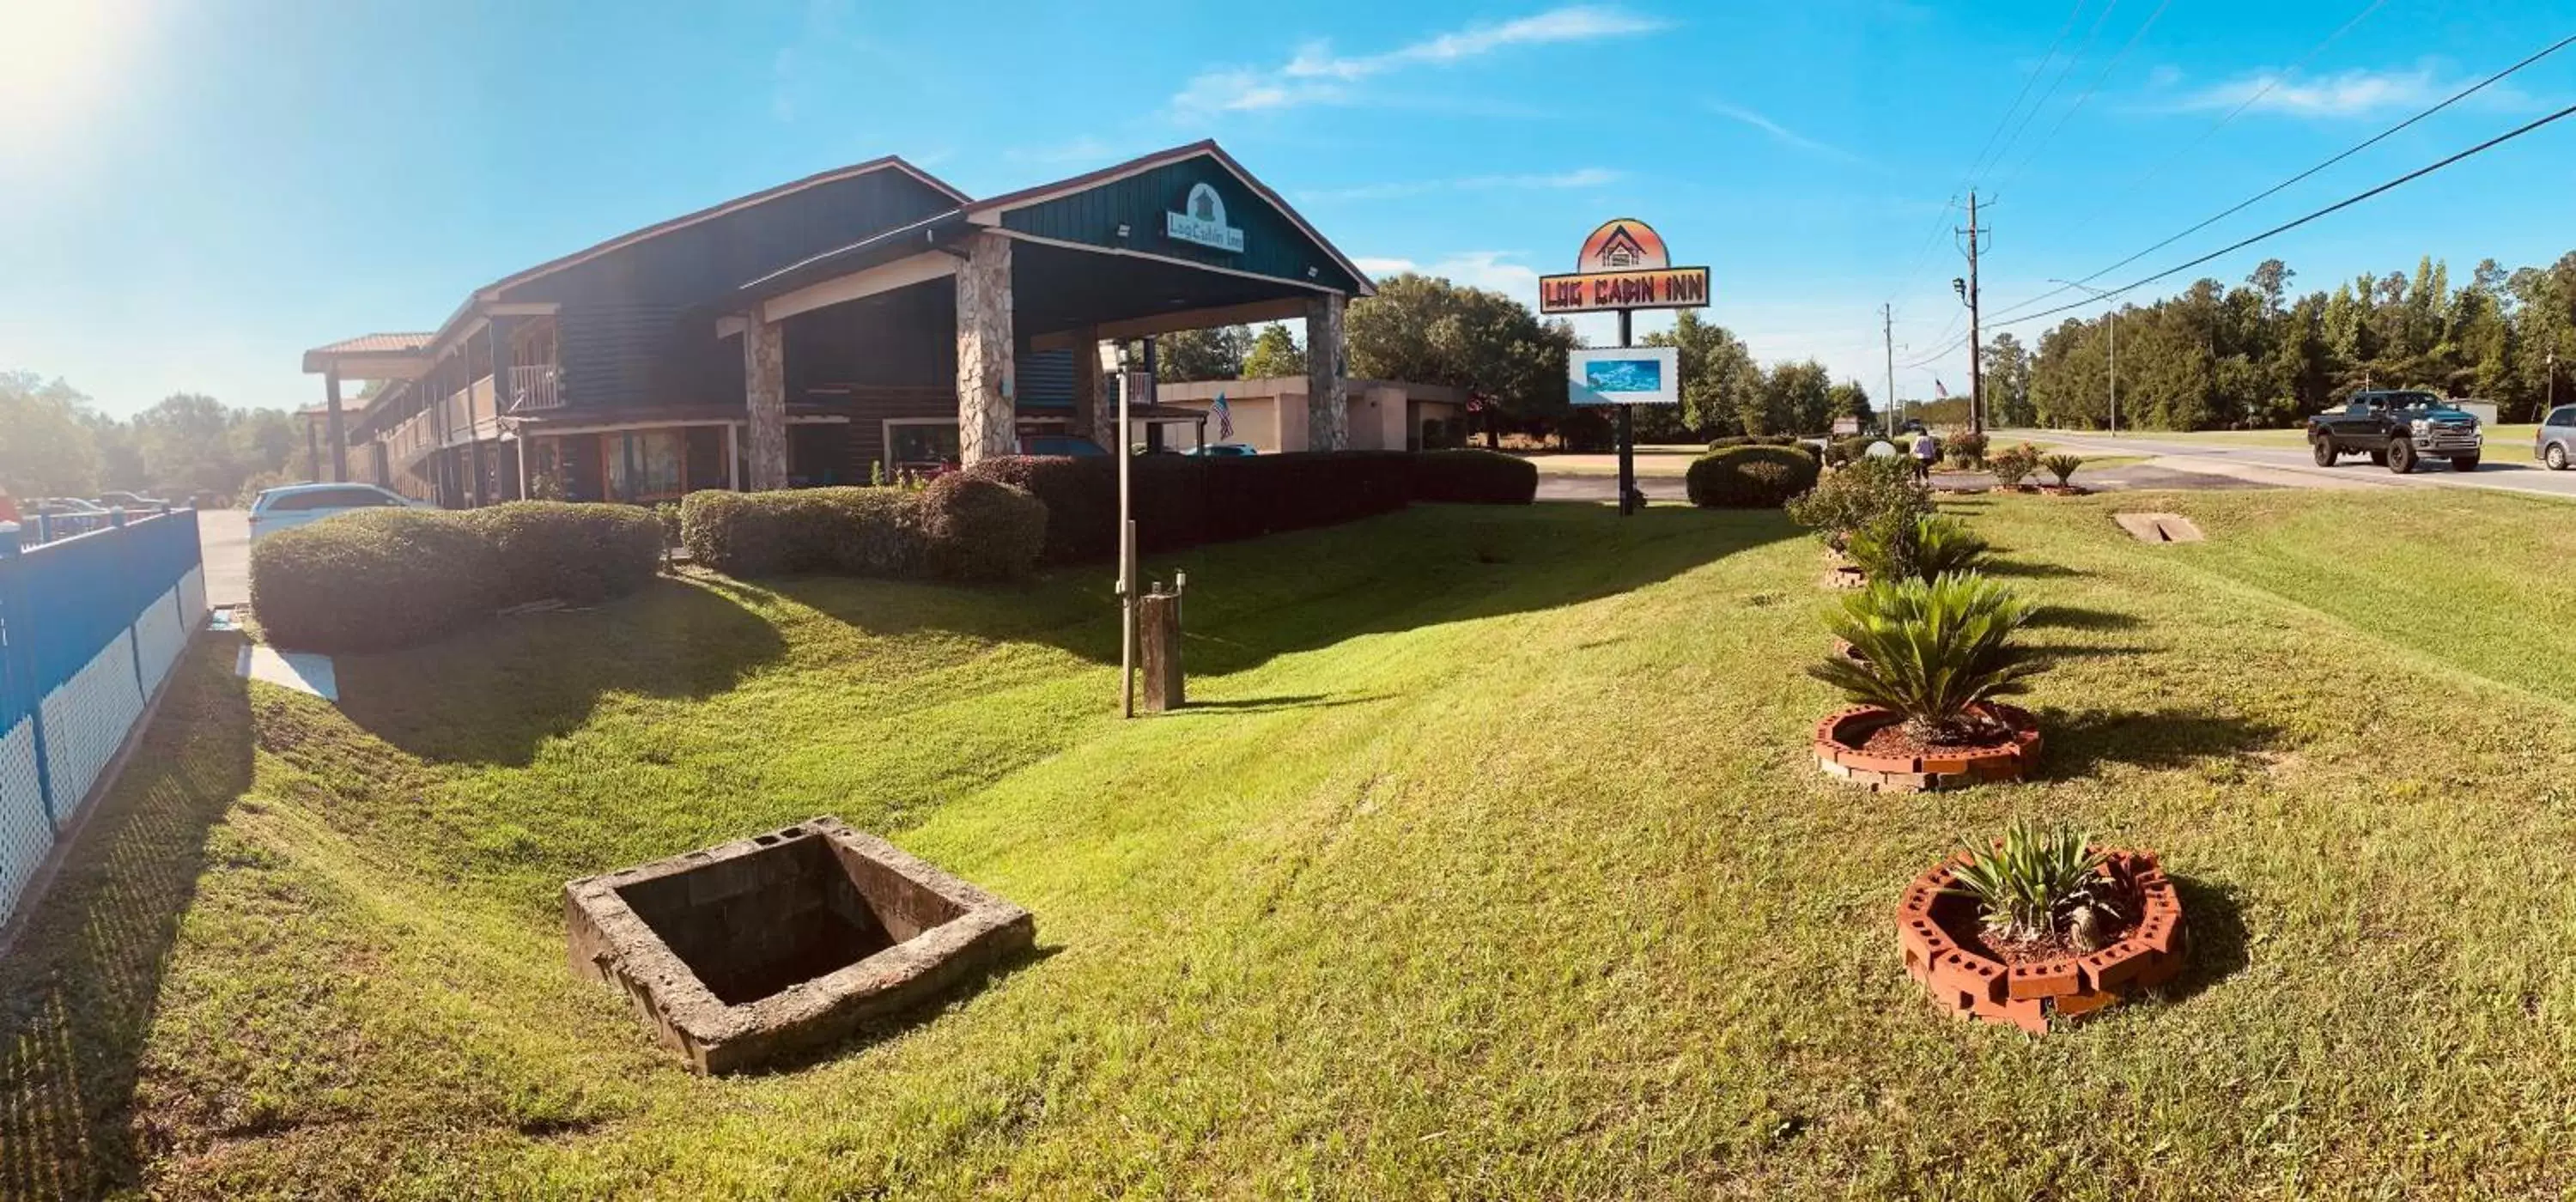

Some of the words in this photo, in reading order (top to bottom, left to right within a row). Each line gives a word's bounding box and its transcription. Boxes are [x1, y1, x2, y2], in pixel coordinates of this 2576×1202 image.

[1546, 280, 1583, 307] LOG
[1595, 275, 1655, 306] CABIN
[1666, 272, 1703, 302] INN
